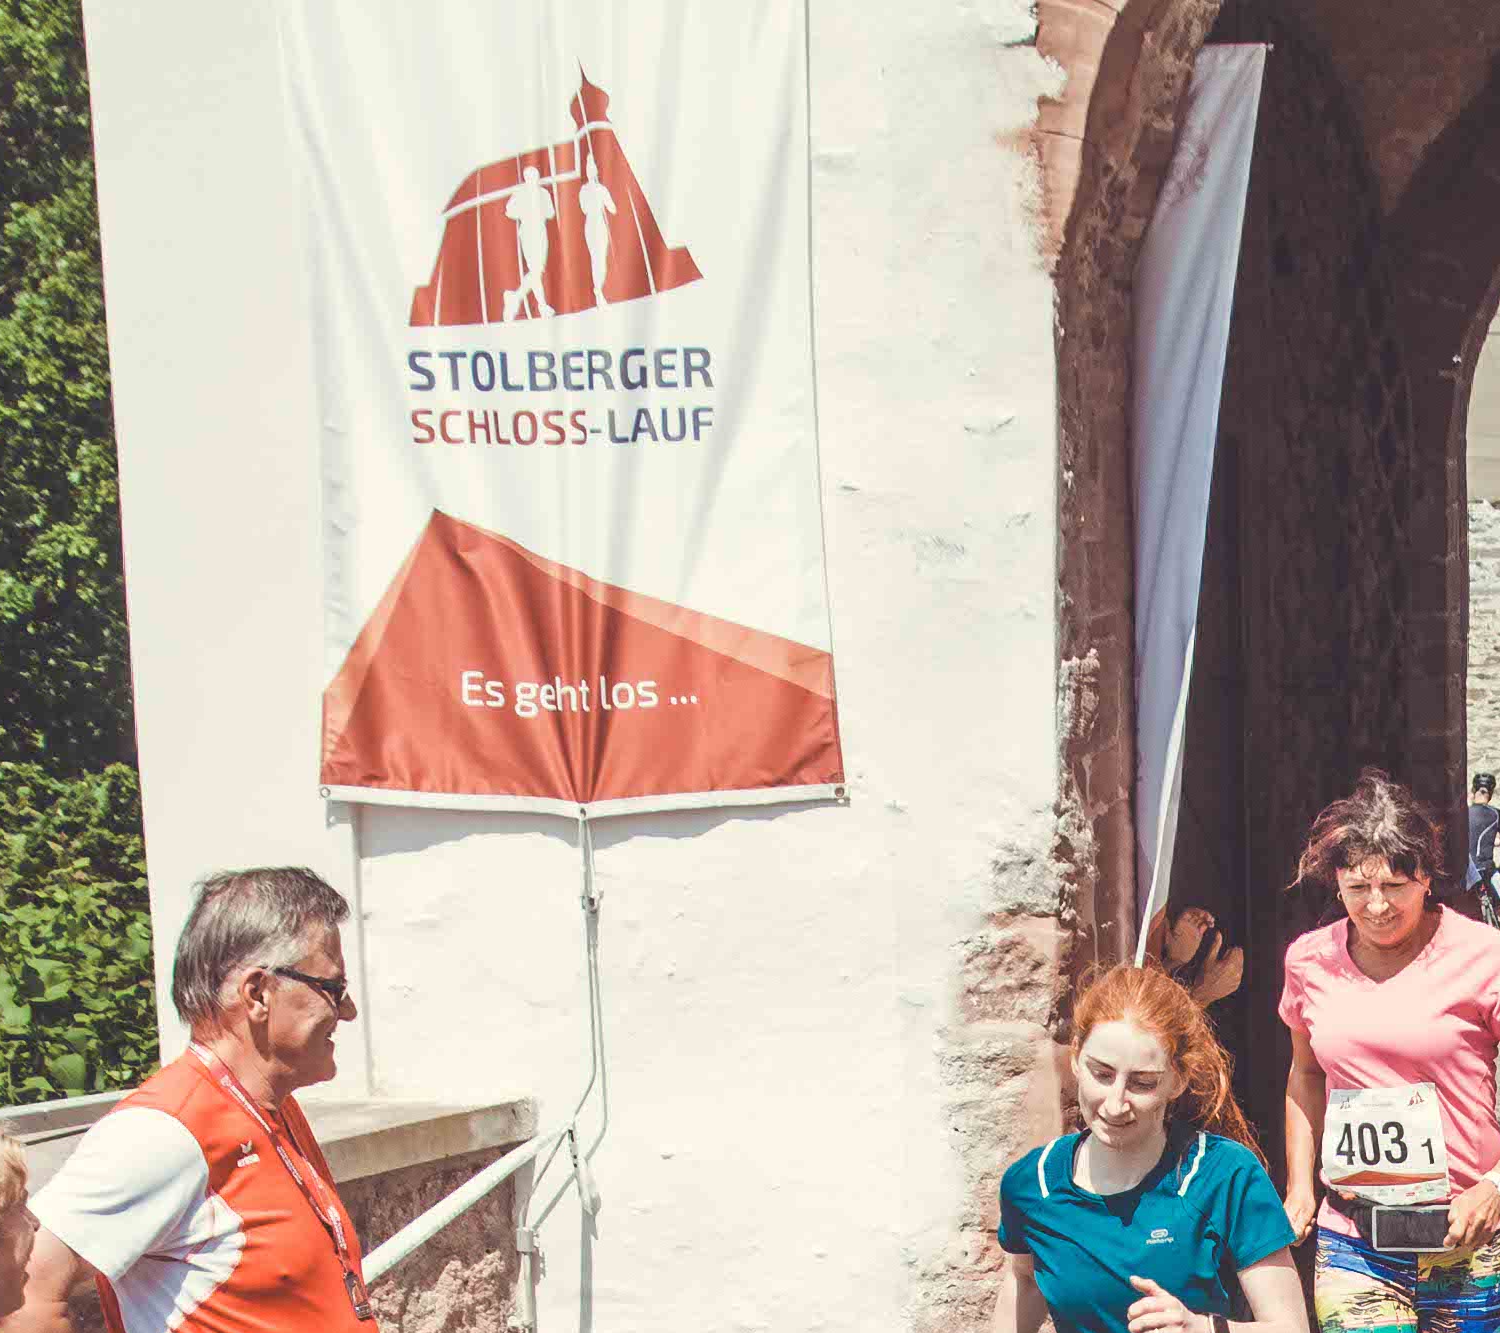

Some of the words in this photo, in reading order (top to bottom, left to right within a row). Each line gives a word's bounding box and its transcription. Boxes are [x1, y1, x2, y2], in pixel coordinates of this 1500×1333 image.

[407, 348, 715, 392] STOLBERGER
[410, 407, 714, 446] SCHLOSS-LAUF
[460, 670, 506, 708] Es
[513, 675, 591, 718] geht
[599, 676, 659, 711] los
[1336, 1121, 1408, 1166] 403
[1421, 1138, 1435, 1164] 1
